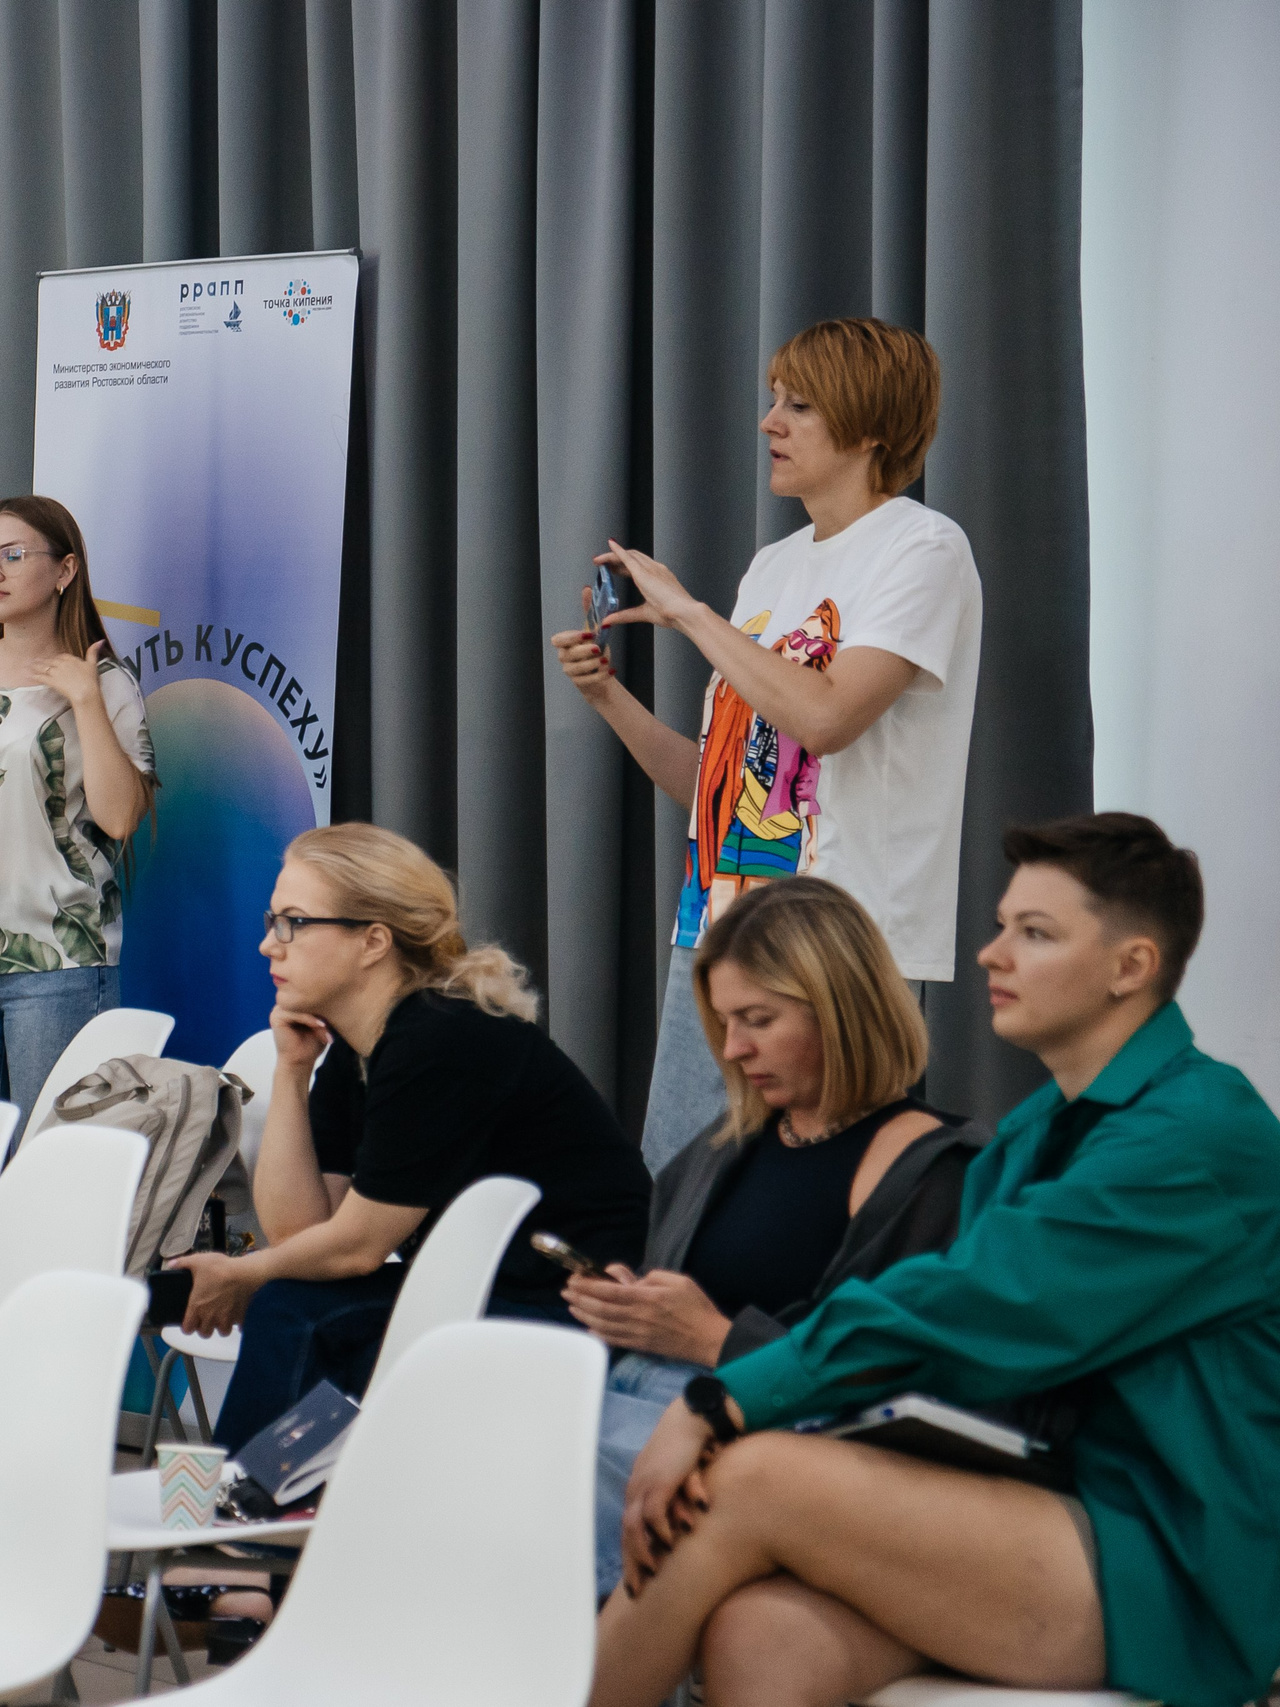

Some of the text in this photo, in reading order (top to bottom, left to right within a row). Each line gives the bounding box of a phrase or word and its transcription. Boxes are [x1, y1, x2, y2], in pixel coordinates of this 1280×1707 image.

[263, 295, 333, 309] точка кипения
[53, 359, 171, 375] Министерство экономического
[54, 373, 169, 391] развития Ростовской области
[122, 624, 329, 789] УТЬ К УСПЕХУ»
